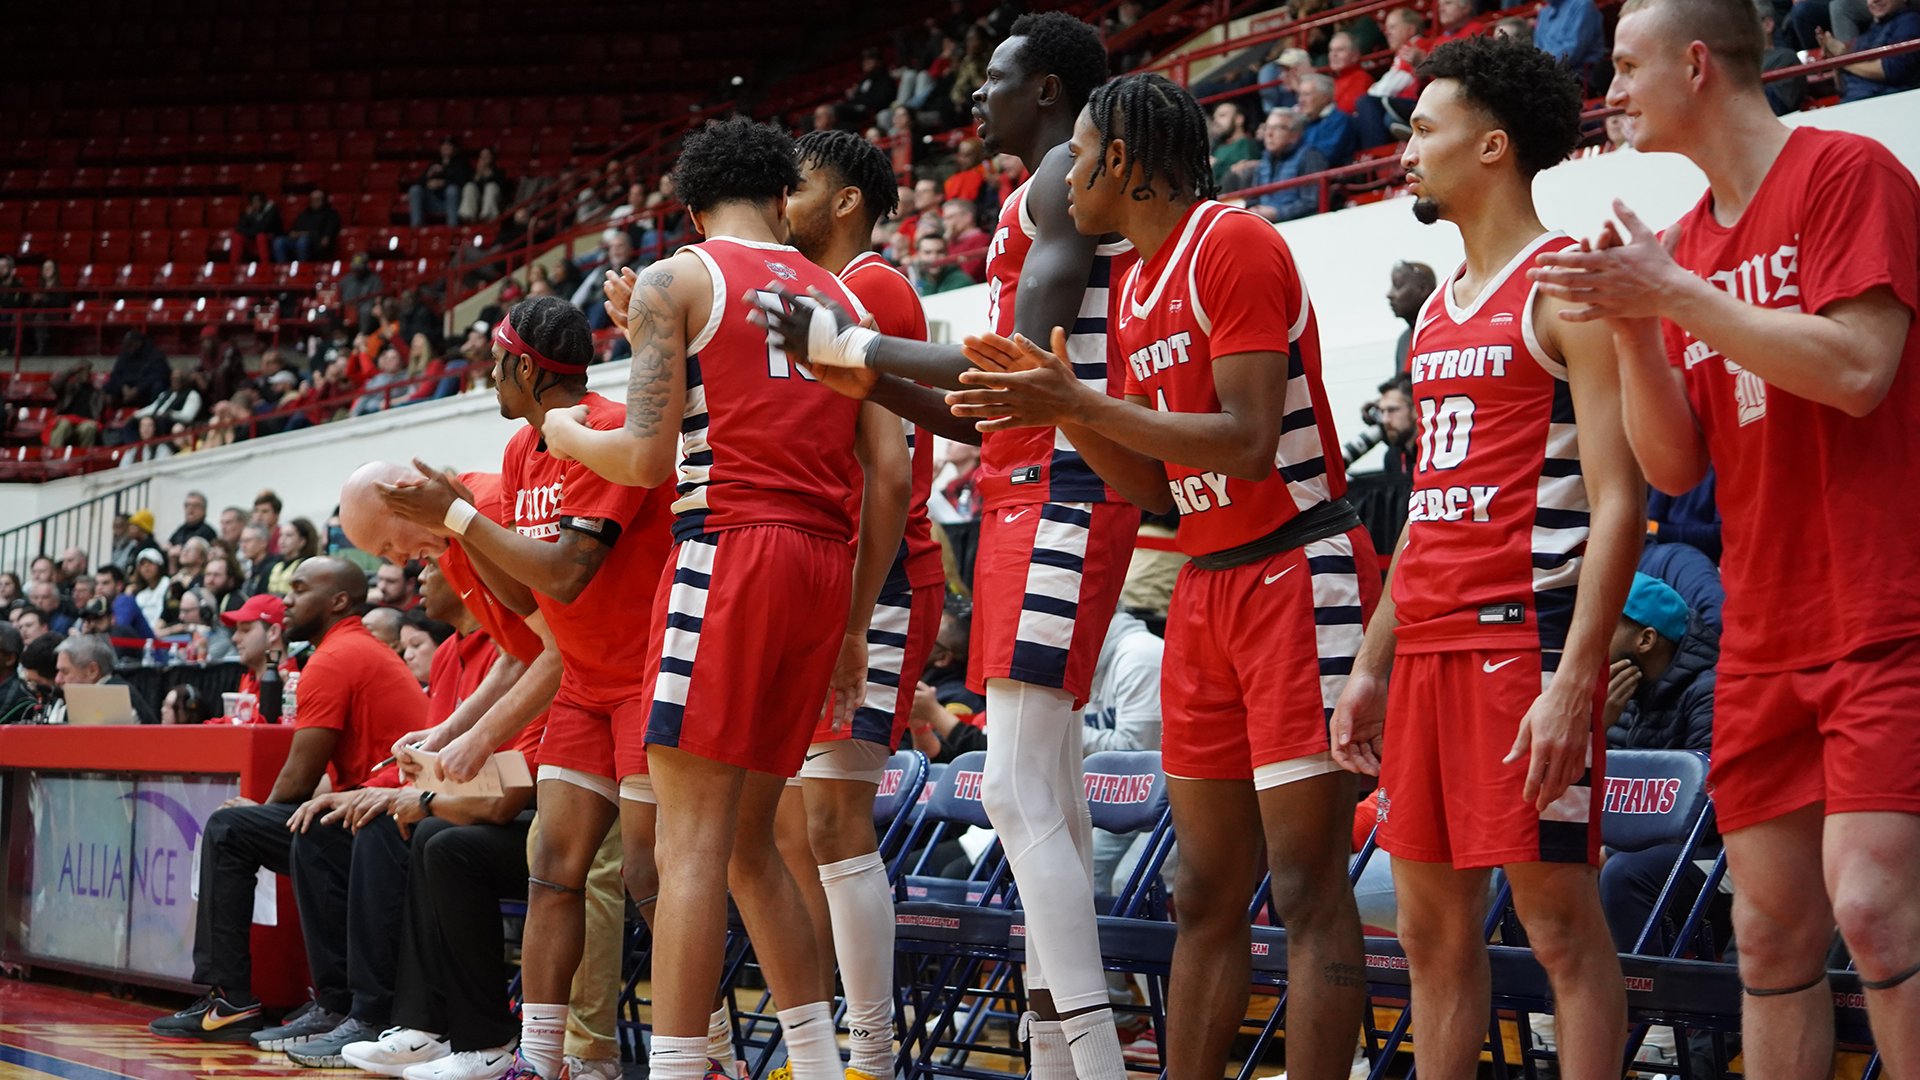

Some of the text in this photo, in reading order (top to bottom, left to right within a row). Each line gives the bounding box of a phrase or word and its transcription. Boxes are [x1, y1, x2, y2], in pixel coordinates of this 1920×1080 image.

[755, 289, 820, 381] 1
[1418, 394, 1476, 474] 10
[1508, 608, 1519, 618] M
[876, 768, 904, 797] ANS
[1082, 772, 1156, 804] TITANS
[58, 842, 177, 906] ALLIANCE
[1251, 942, 1269, 955] EAM
[1365, 953, 1390, 968] TROITS
[1624, 976, 1654, 991] TEAM
